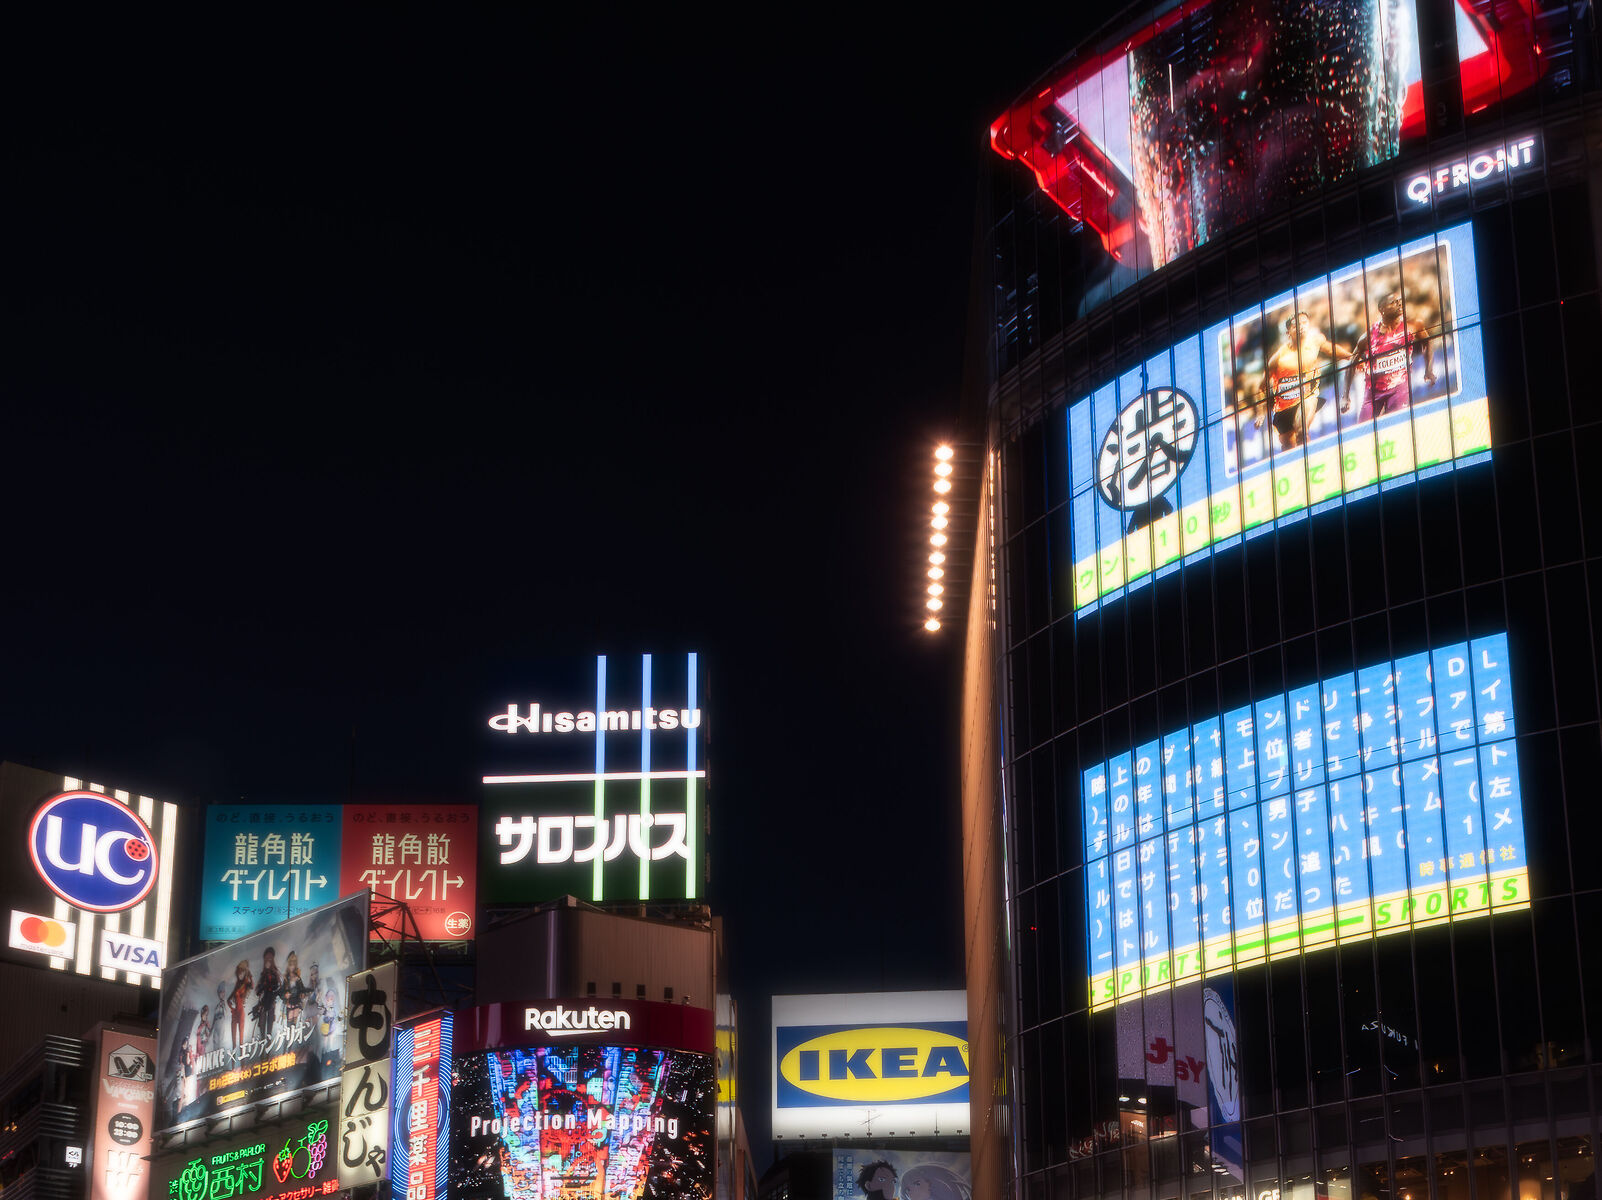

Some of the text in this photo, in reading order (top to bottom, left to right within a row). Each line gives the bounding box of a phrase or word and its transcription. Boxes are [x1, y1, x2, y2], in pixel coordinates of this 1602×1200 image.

[488, 703, 701, 733] Hisamitsu
[235, 833, 315, 865] 龍角散
[372, 833, 451, 865] 龍角散
[495, 812, 691, 865] サロンパス
[220, 869, 328, 901] ダイレクト
[358, 869, 465, 901] ダイレクト
[232, 906, 274, 915] スティック
[1376, 878, 1519, 926] SPORTS
[106, 940, 160, 967] VISA
[525, 1005, 631, 1031] Rakuten
[237, 1020, 316, 1061] エヴァンゲリオン
[341, 973, 392, 1178] もんじゃ
[799, 1046, 970, 1081] IKEA
[471, 1109, 678, 1139] Projection Mapping
